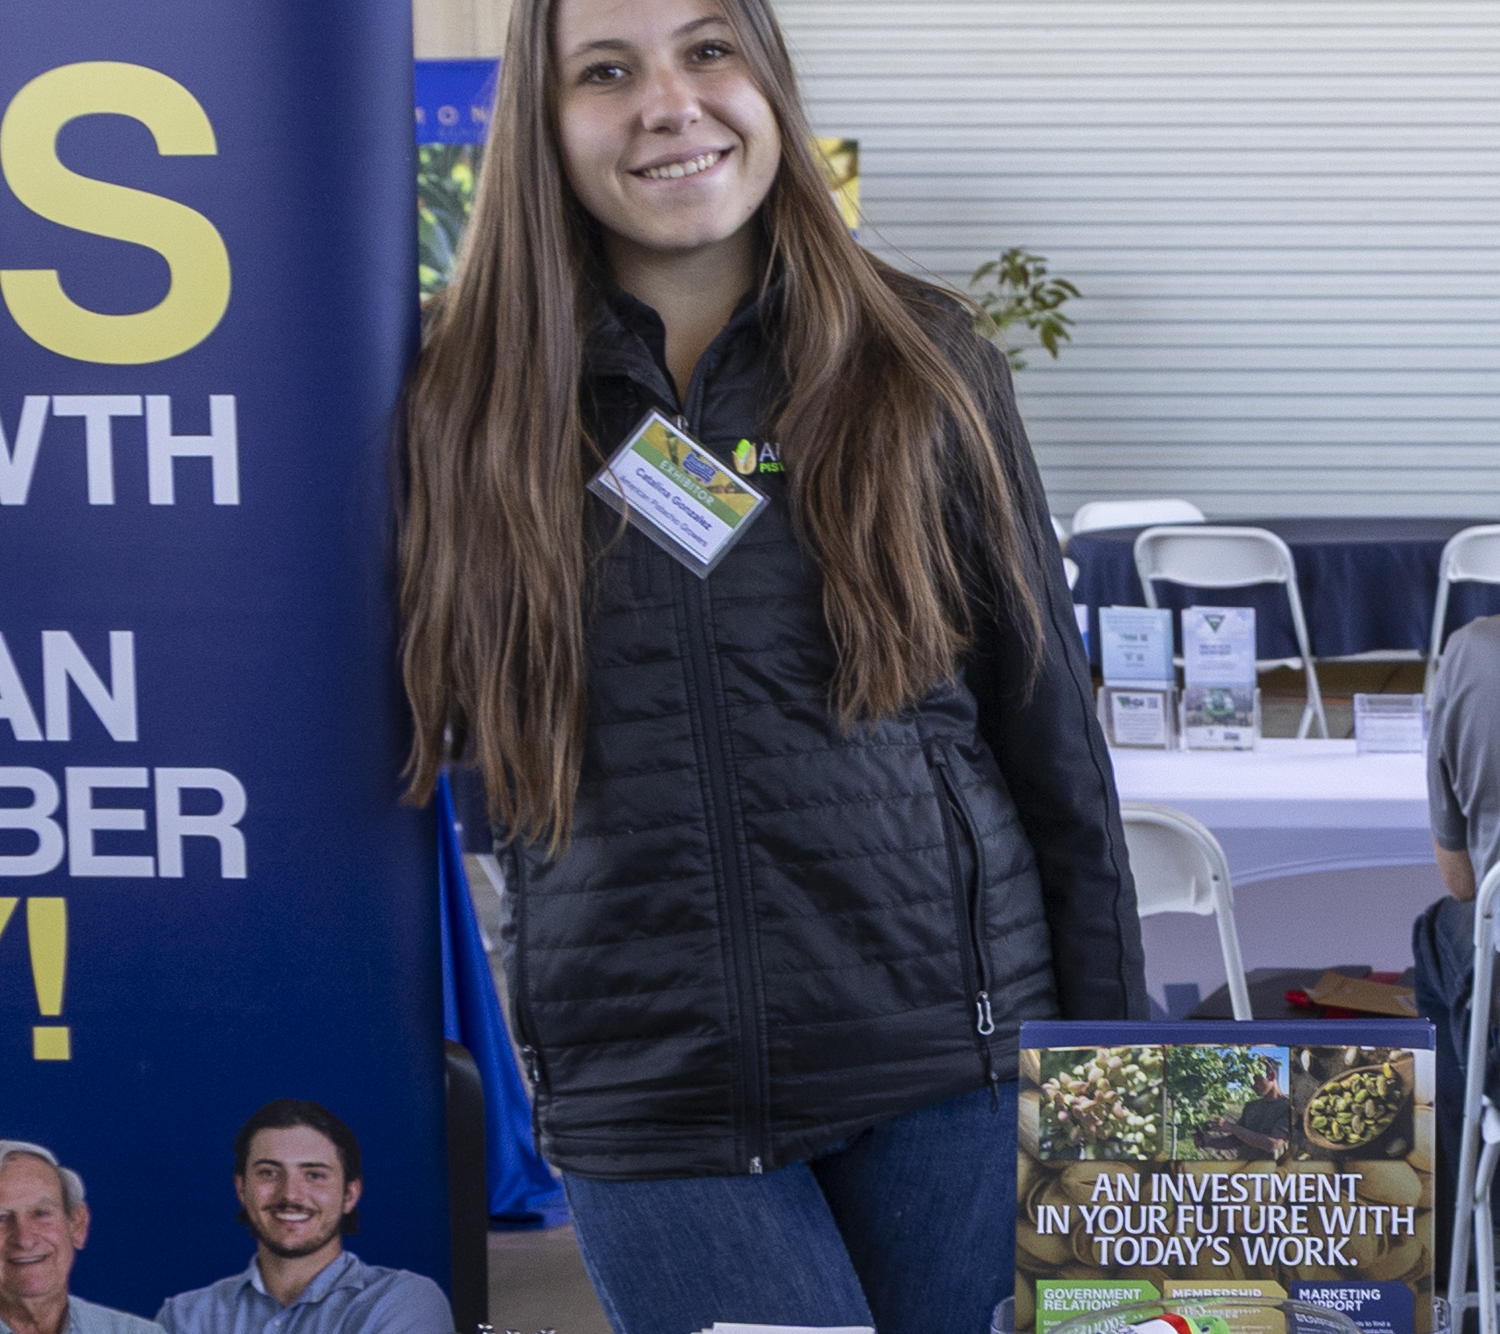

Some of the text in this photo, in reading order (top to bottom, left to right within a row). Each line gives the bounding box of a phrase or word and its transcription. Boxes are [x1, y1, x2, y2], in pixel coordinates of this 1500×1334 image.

[659, 460, 716, 506] EXHIBITOR
[1090, 1173, 1362, 1203] AN INVESTMENT
[1036, 1205, 1415, 1236] IN YOUR FUTURE WITH
[1094, 1236, 1358, 1267] TODAY'S WORK.
[1043, 1288, 1142, 1300] GOVERNMENT
[1298, 1288, 1381, 1301] MARKETING
